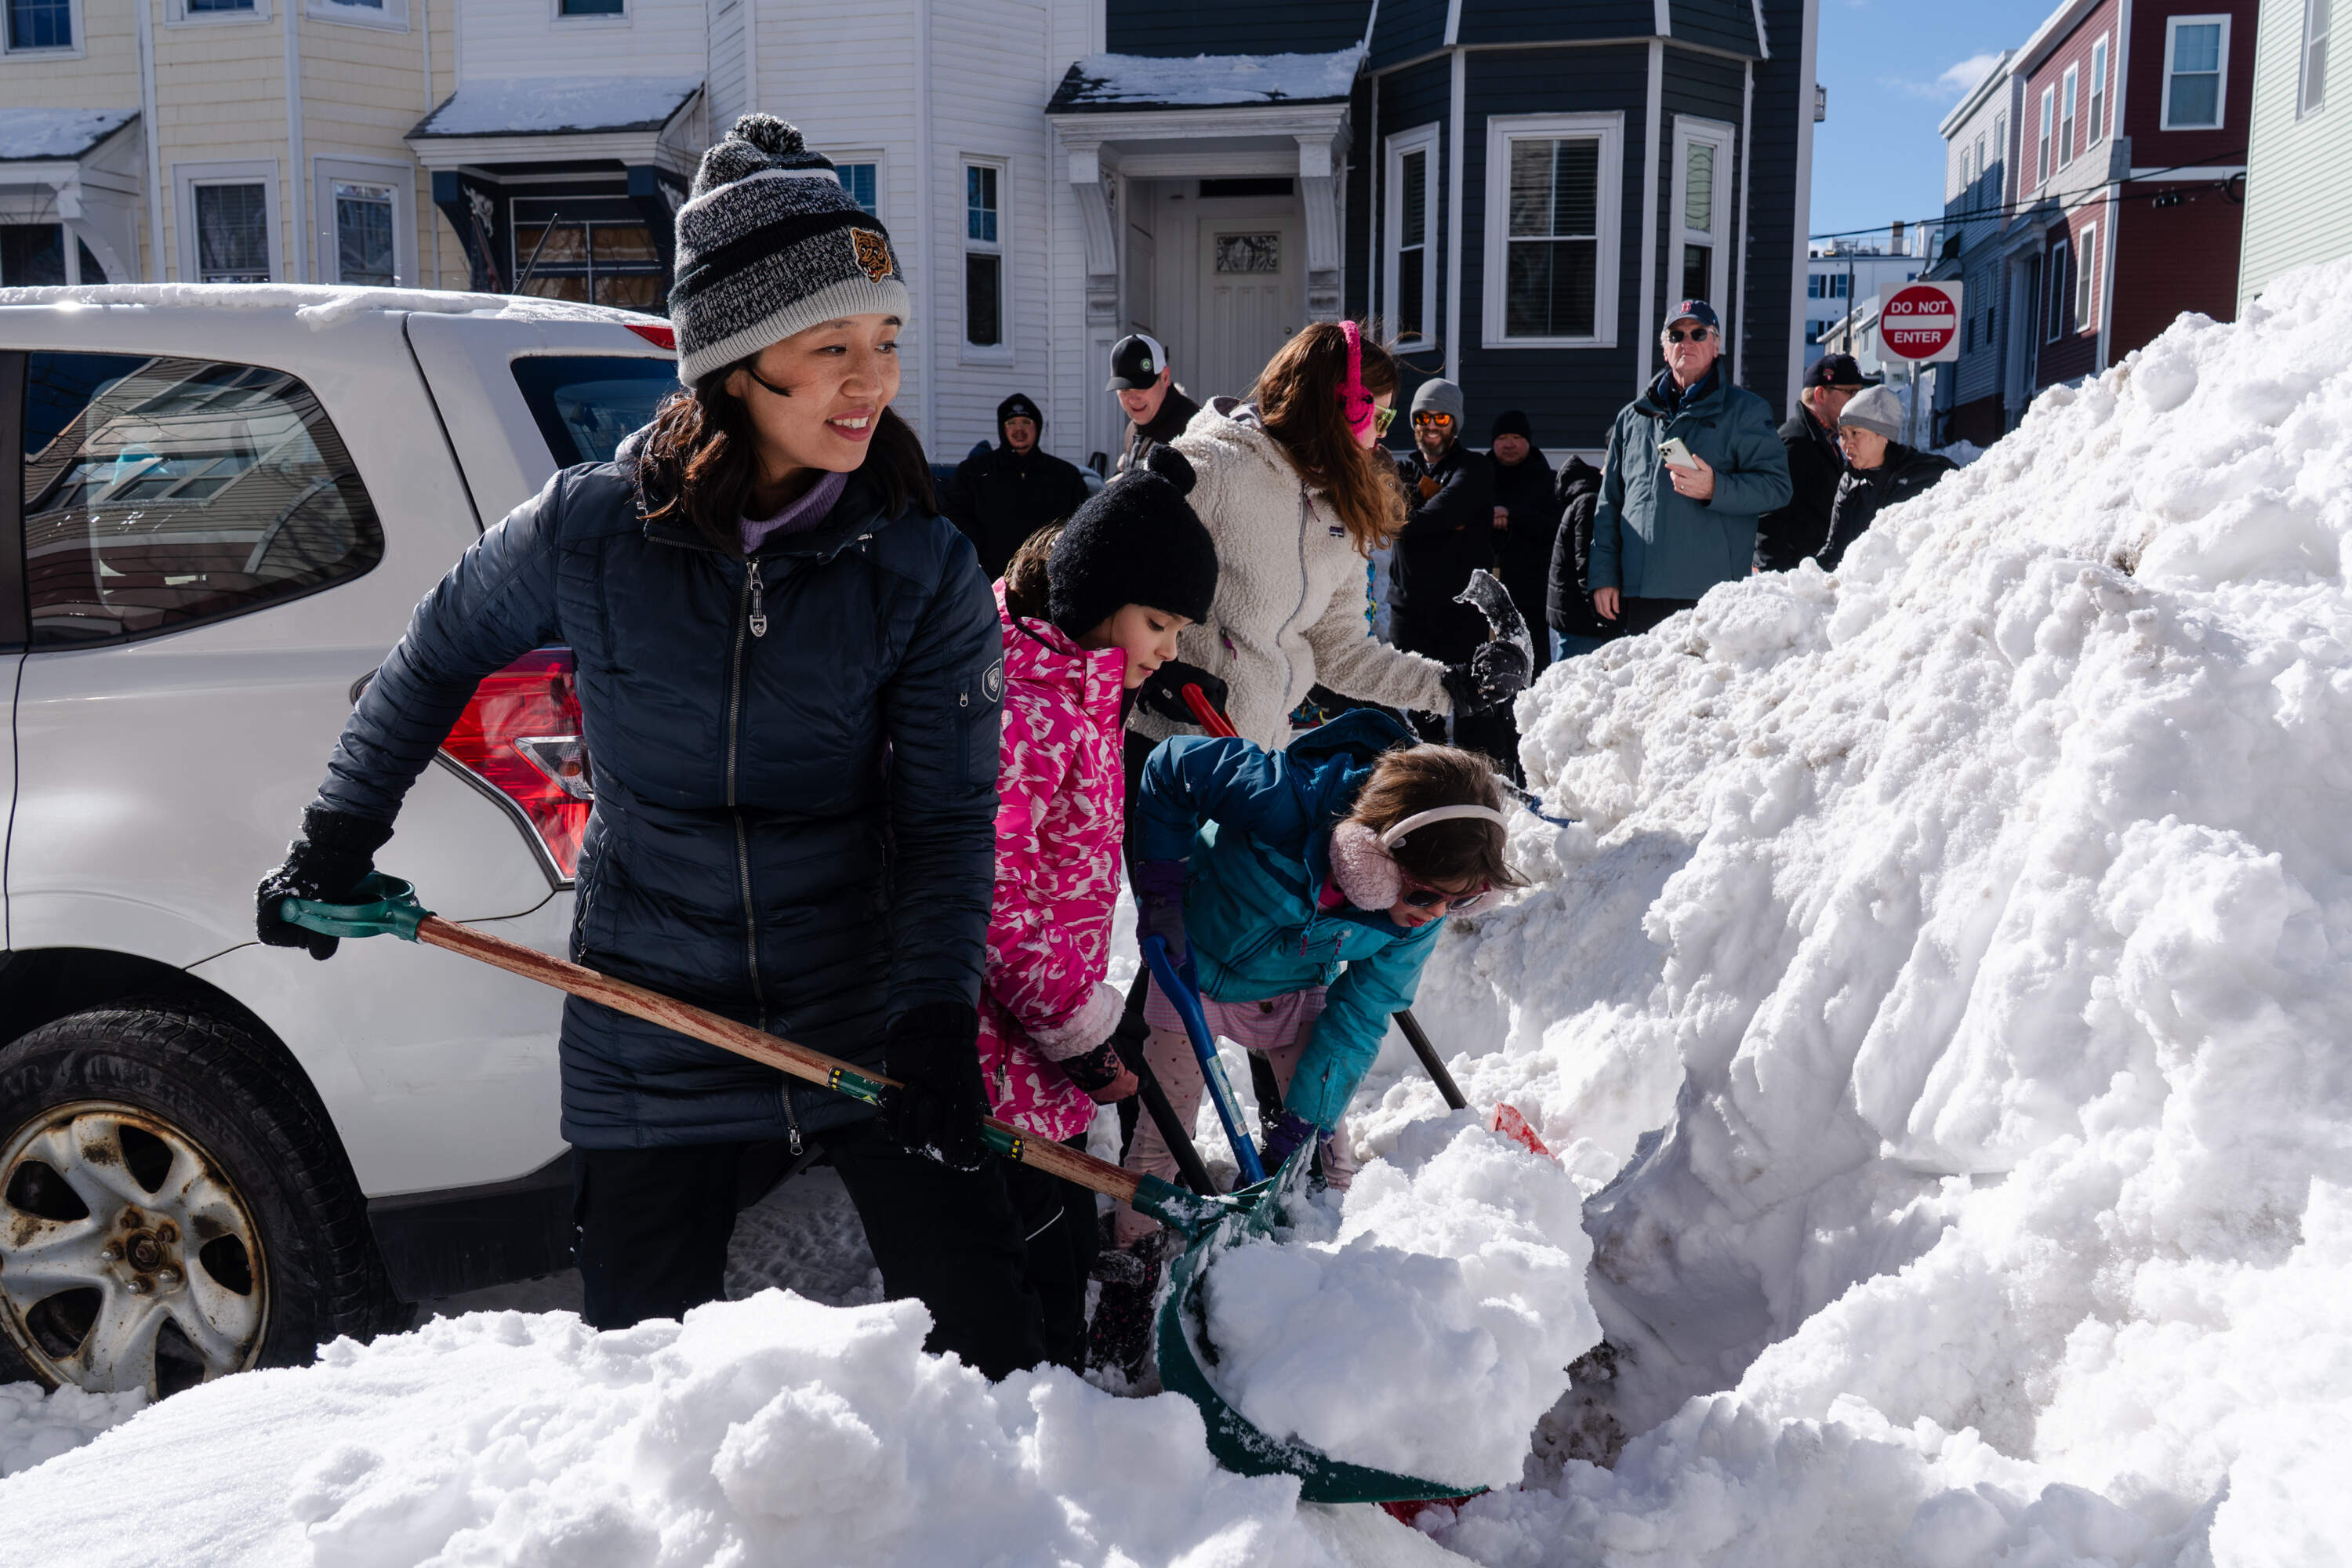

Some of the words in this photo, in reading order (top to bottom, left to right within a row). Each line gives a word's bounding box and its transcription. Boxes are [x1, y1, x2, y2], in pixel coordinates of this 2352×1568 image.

[1891, 301, 1913, 314] DO
[1918, 300, 1948, 313] NOT
[1894, 332, 1941, 343] ENTER
